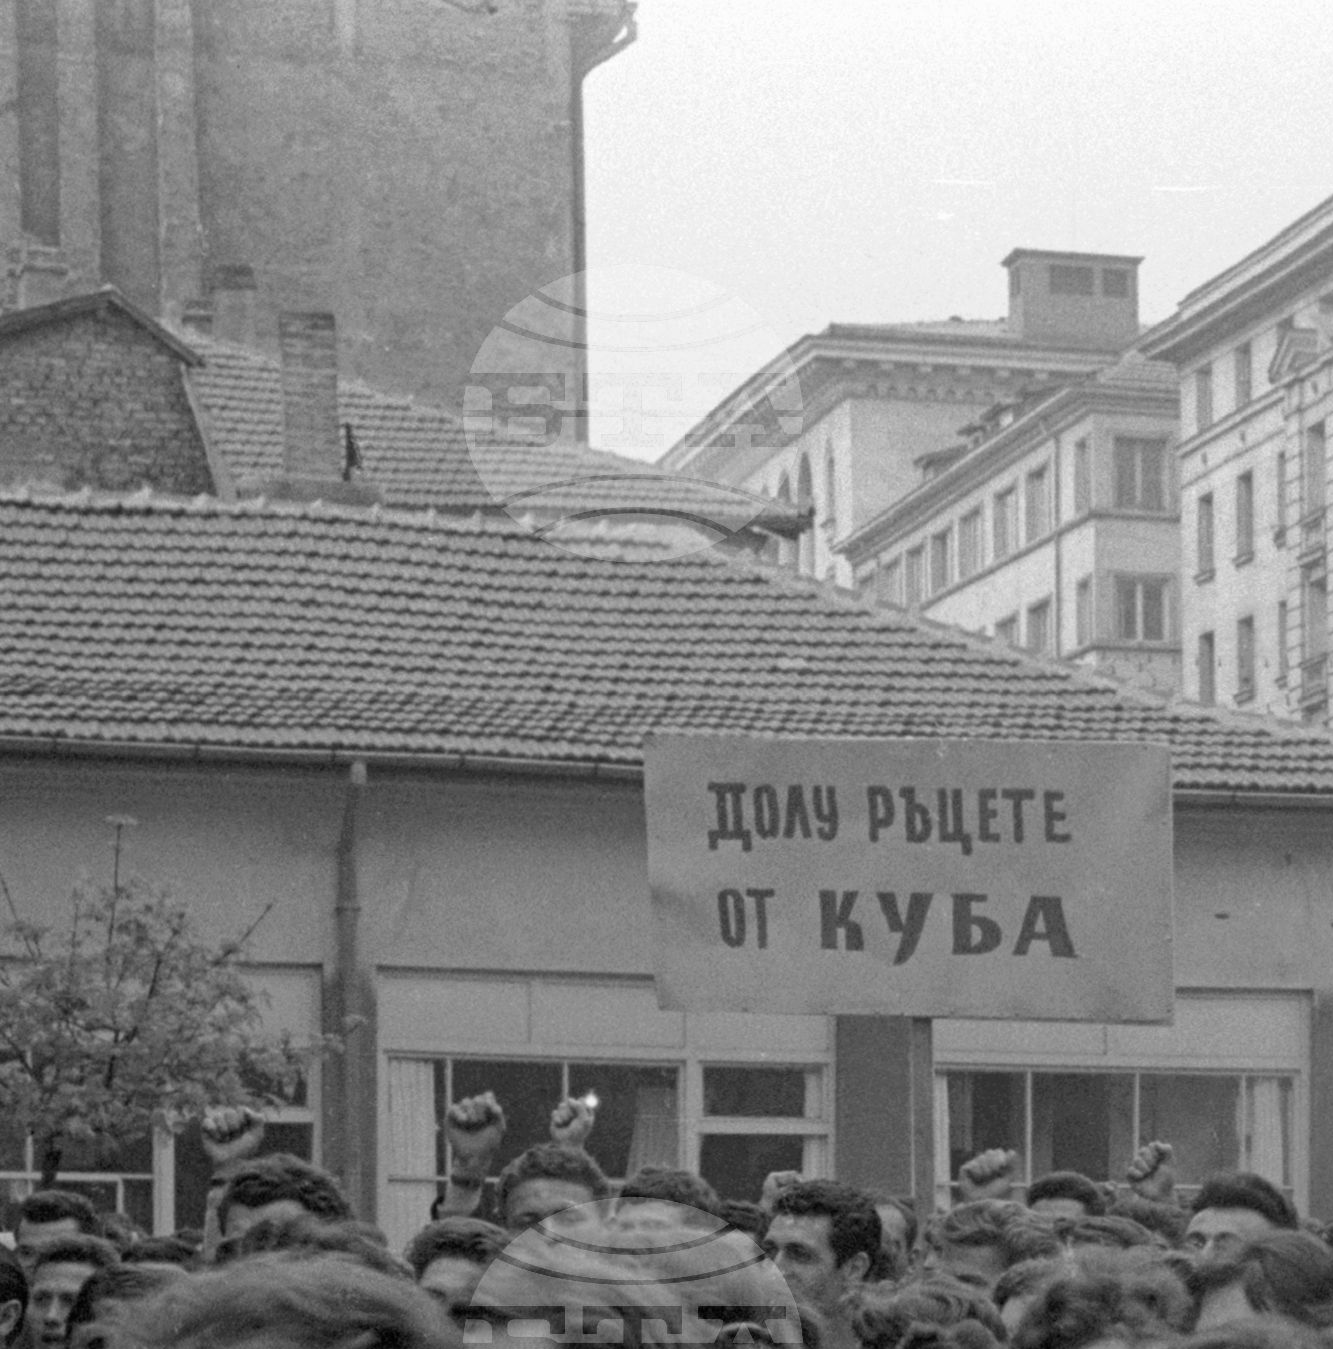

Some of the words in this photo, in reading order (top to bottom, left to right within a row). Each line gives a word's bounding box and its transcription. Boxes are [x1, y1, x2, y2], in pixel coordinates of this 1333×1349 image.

[707, 781, 840, 852] ДОЛУ
[866, 785, 1073, 856] РЪЦЕТЕ
[716, 887, 776, 949] ОТ
[818, 889, 1079, 966] КУБА
